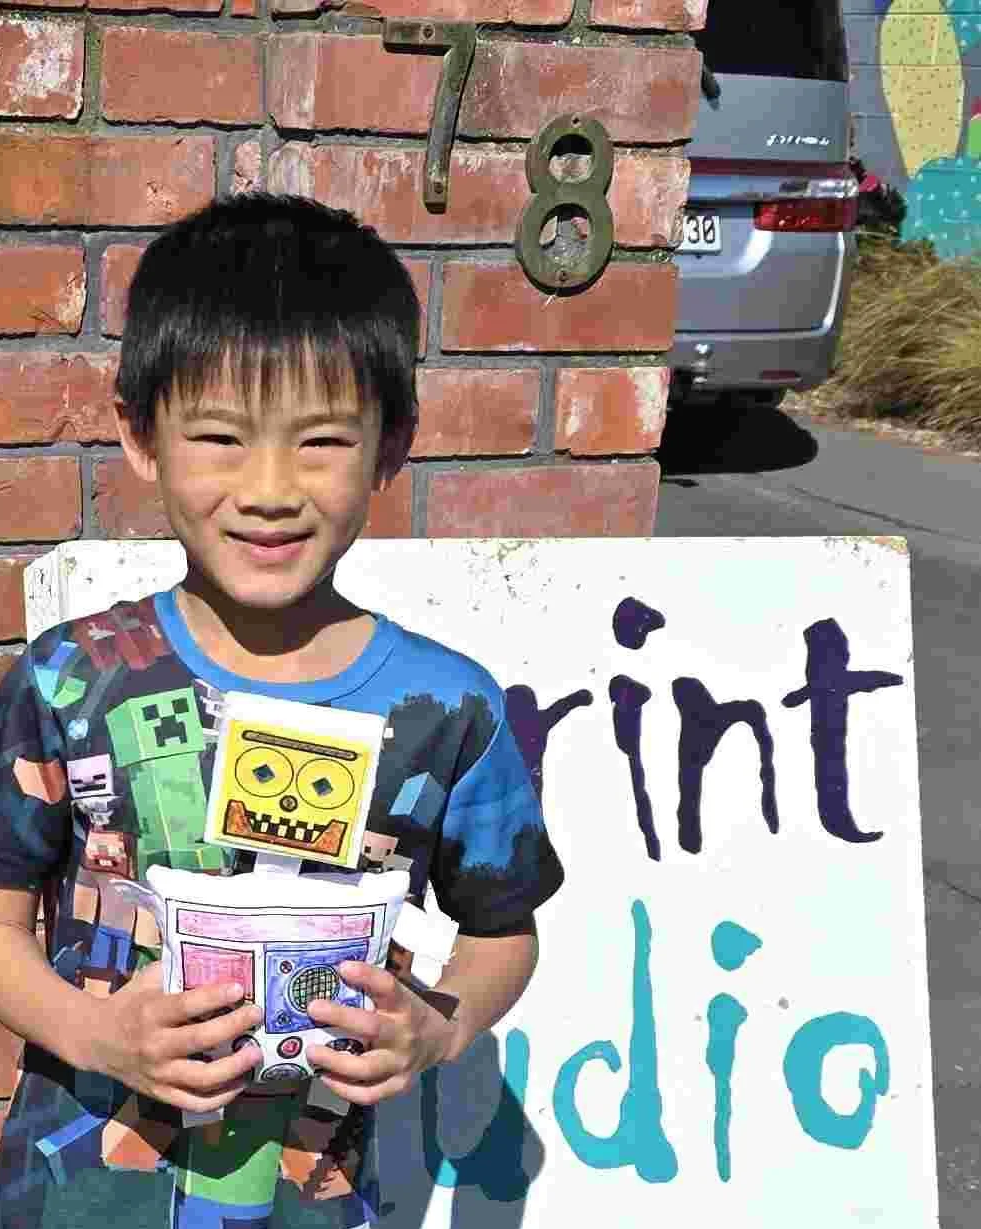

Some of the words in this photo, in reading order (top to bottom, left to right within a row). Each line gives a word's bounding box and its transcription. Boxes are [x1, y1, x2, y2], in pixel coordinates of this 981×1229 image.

[682, 215, 716, 244] 30
[505, 597, 904, 862] rint
[420, 898, 891, 1203] udio
